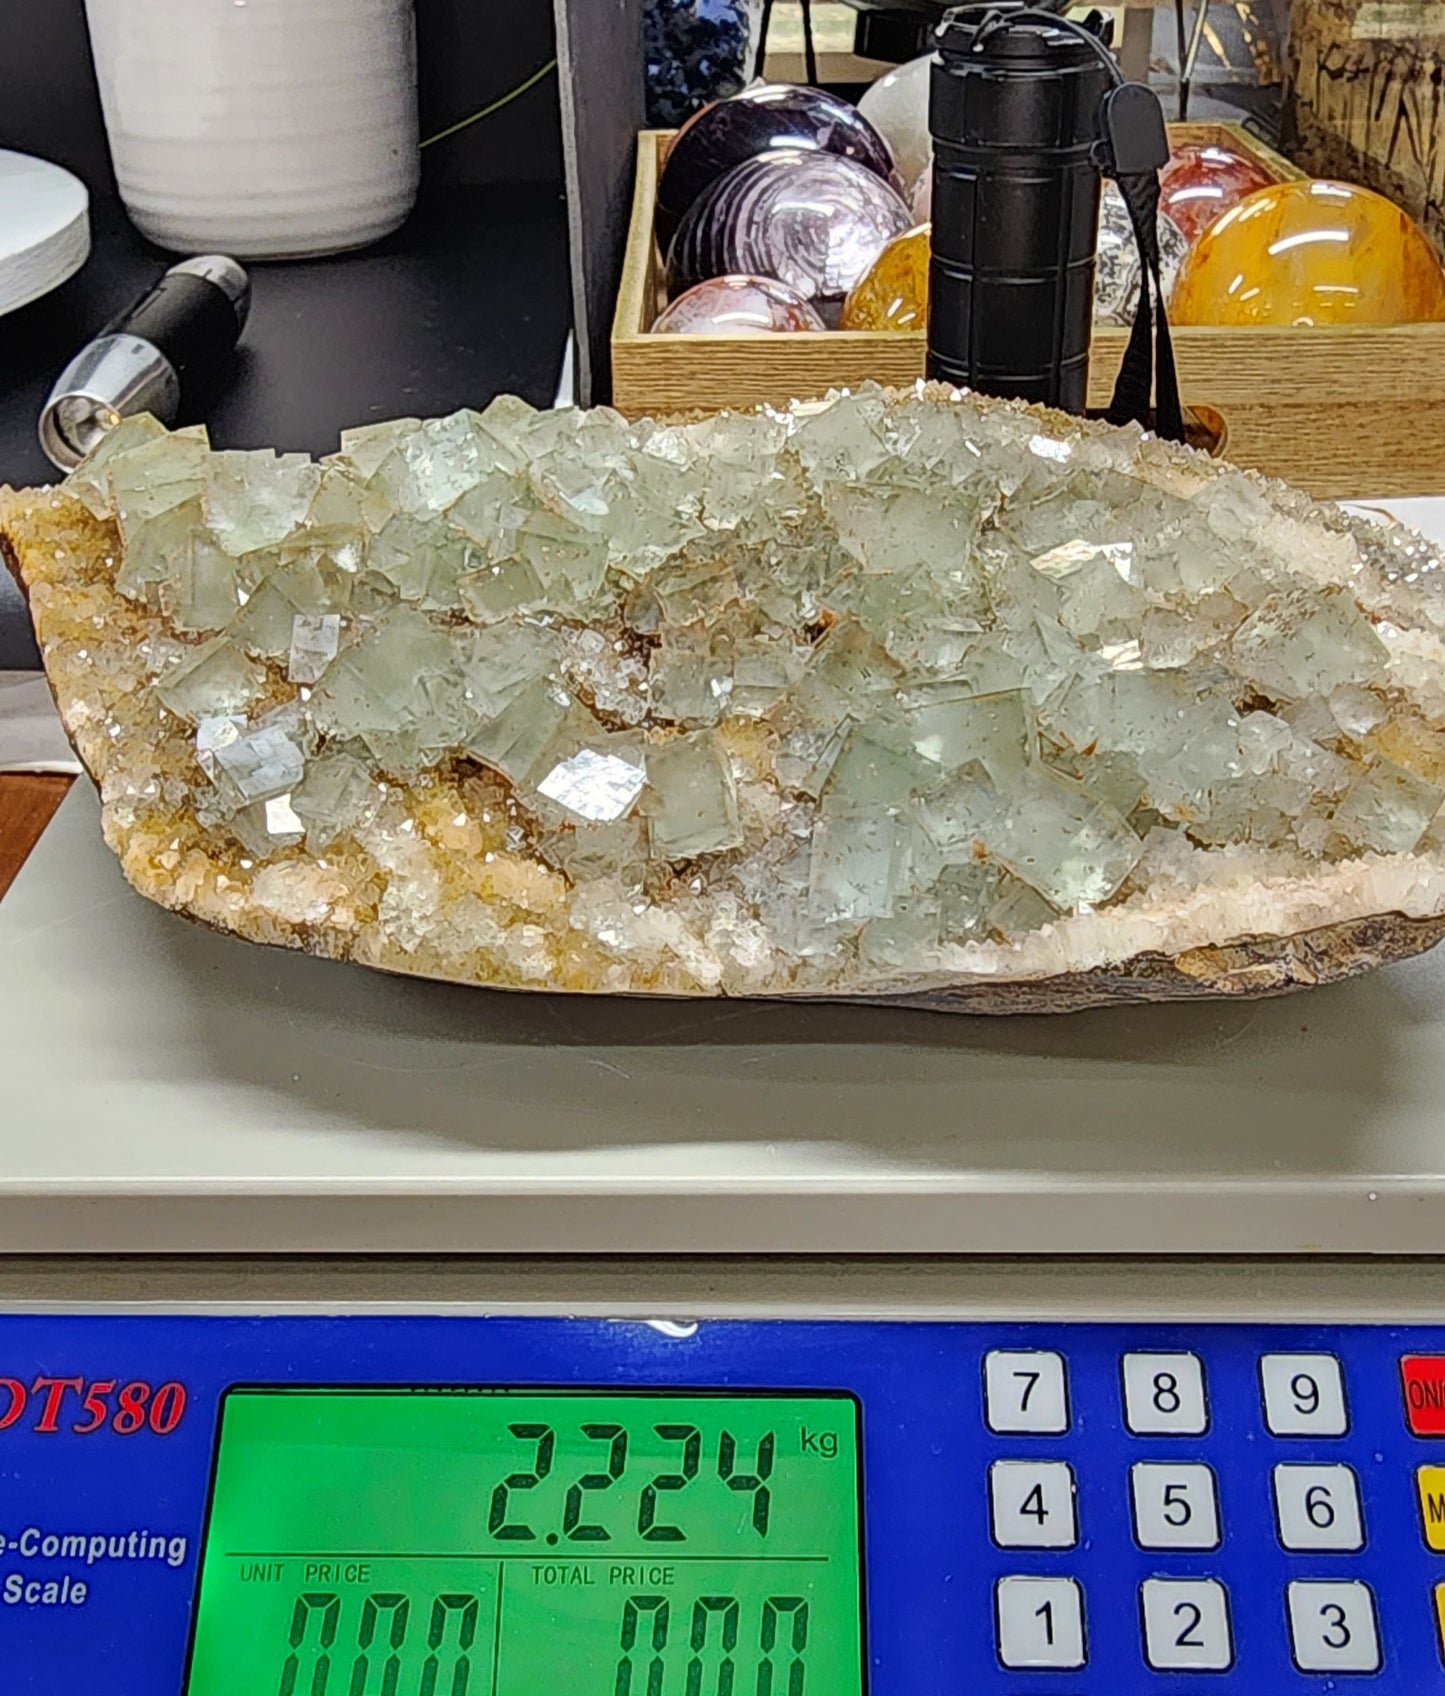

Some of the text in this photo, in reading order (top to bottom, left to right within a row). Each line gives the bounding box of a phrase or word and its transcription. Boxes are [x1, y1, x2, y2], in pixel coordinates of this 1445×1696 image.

[1013, 1372, 1040, 1412] 7
[1152, 1372, 1181, 1413] 8
[1290, 1373, 1320, 1414] 9
[489, 1424, 838, 1542] 2.224 kg
[1019, 1484, 1049, 1525] 4
[1162, 1485, 1192, 1526] 5
[1304, 1486, 1335, 1528] 6
[3, 1574, 87, 1604] Scale
[240, 1564, 371, 1583] UNIT PRICE
[532, 1566, 675, 1585] TOTAL PRICE
[1034, 1601, 1054, 1645] 1
[1173, 1602, 1204, 1647] 2
[1319, 1604, 1351, 1648] 3
